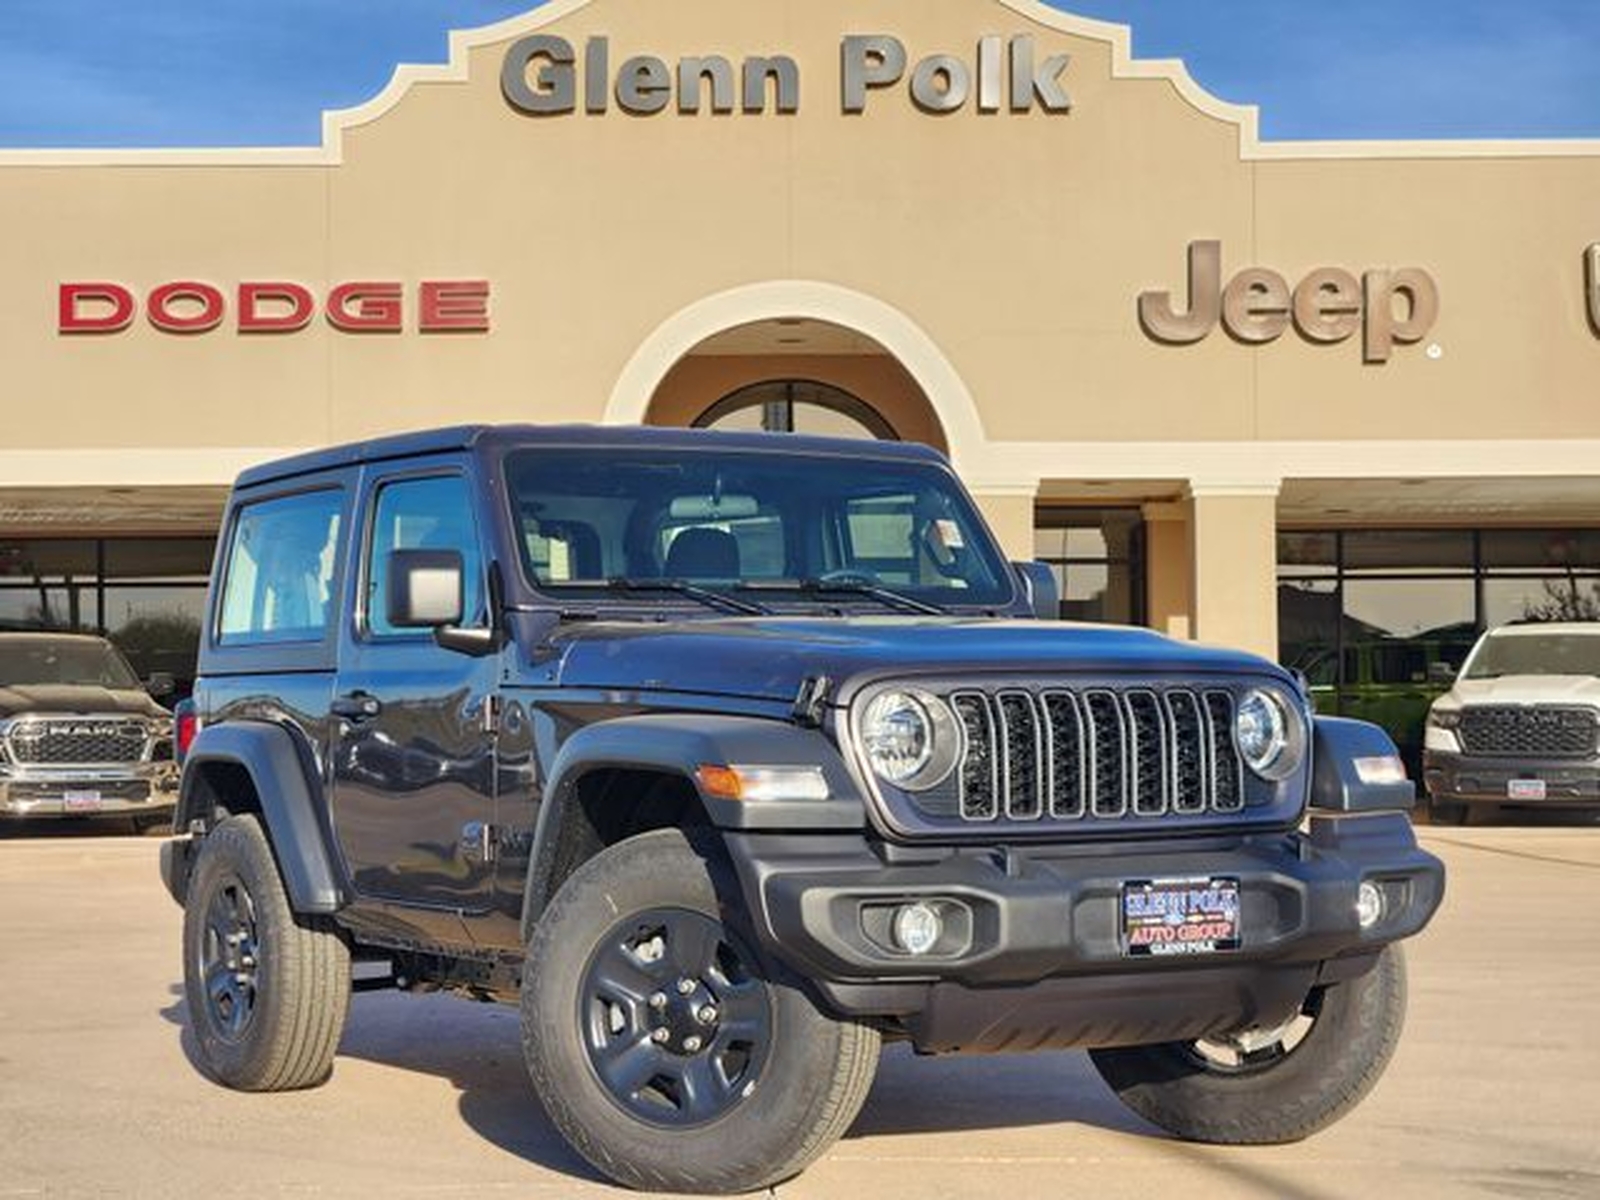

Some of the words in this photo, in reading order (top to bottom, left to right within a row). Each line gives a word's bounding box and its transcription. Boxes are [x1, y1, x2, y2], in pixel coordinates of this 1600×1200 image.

[500, 34, 799, 115] Glenn
[841, 34, 1072, 113] Polk
[58, 281, 491, 335] DODGE
[1137, 240, 1439, 364] Jeep
[1130, 925, 1175, 945] AUTO
[1177, 922, 1232, 941] GROUP
